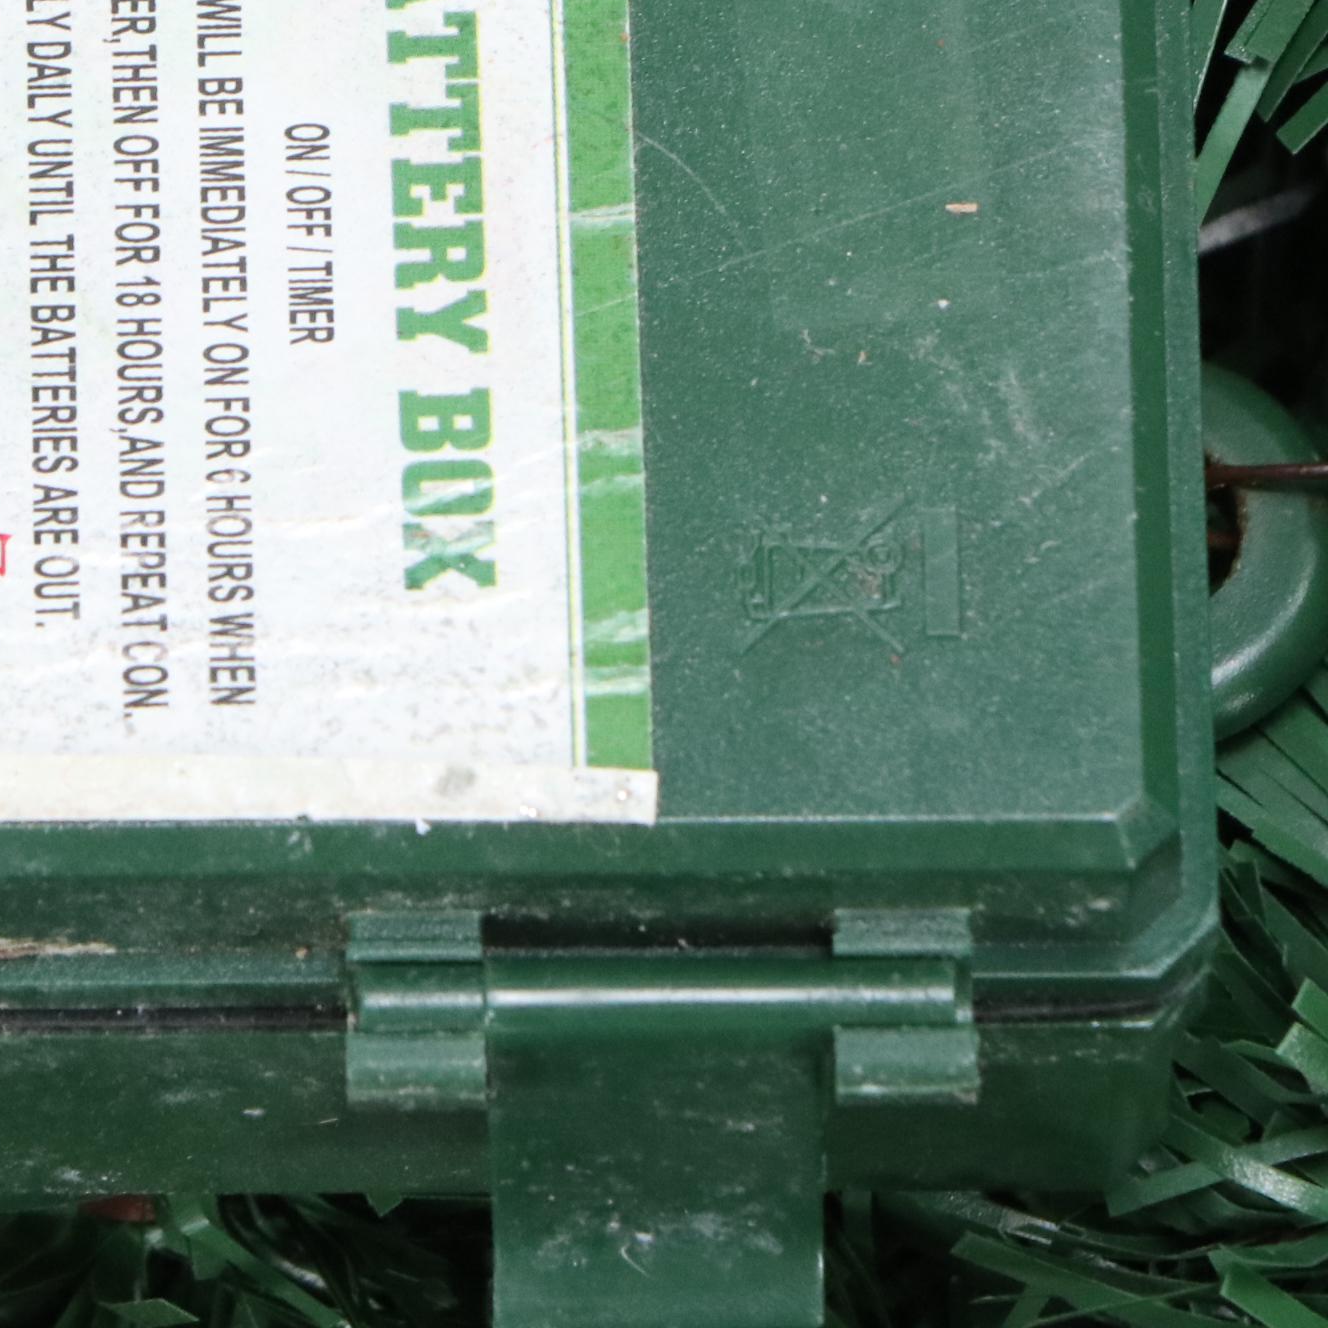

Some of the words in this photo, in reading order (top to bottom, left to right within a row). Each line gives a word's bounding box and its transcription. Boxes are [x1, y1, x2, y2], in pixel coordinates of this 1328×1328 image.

[26, 41, 74, 131] DAILY
[197, 78, 243, 117] BE
[112, 135, 160, 192] OFF
[284, 123, 330, 161] ON
[27, 139, 75, 227] UNTIL
[285, 170, 332, 179] /
[112, 203, 162, 266] FOR
[198, 126, 249, 333] IMMEDIATELY
[285, 185, 332, 238] OFF
[28, 233, 76, 294] THE
[286, 246, 333, 255] /
[114, 275, 162, 308] 18
[287, 260, 335, 345] TIMER
[29, 305, 80, 474] BATTERIES
[201, 343, 249, 387] ON
[108, 318, 165, 500] HOURS,AND
[204, 397, 252, 459] FOR
[206, 468, 252, 484] 6
[397, 388, 498, 592] BOX
[31, 483, 79, 545] ARE
[118, 510, 168, 632] REPEAT
[205, 495, 255, 603] HOURS
[33, 555, 81, 628] OUT.
[207, 613, 256, 707] WHEN
